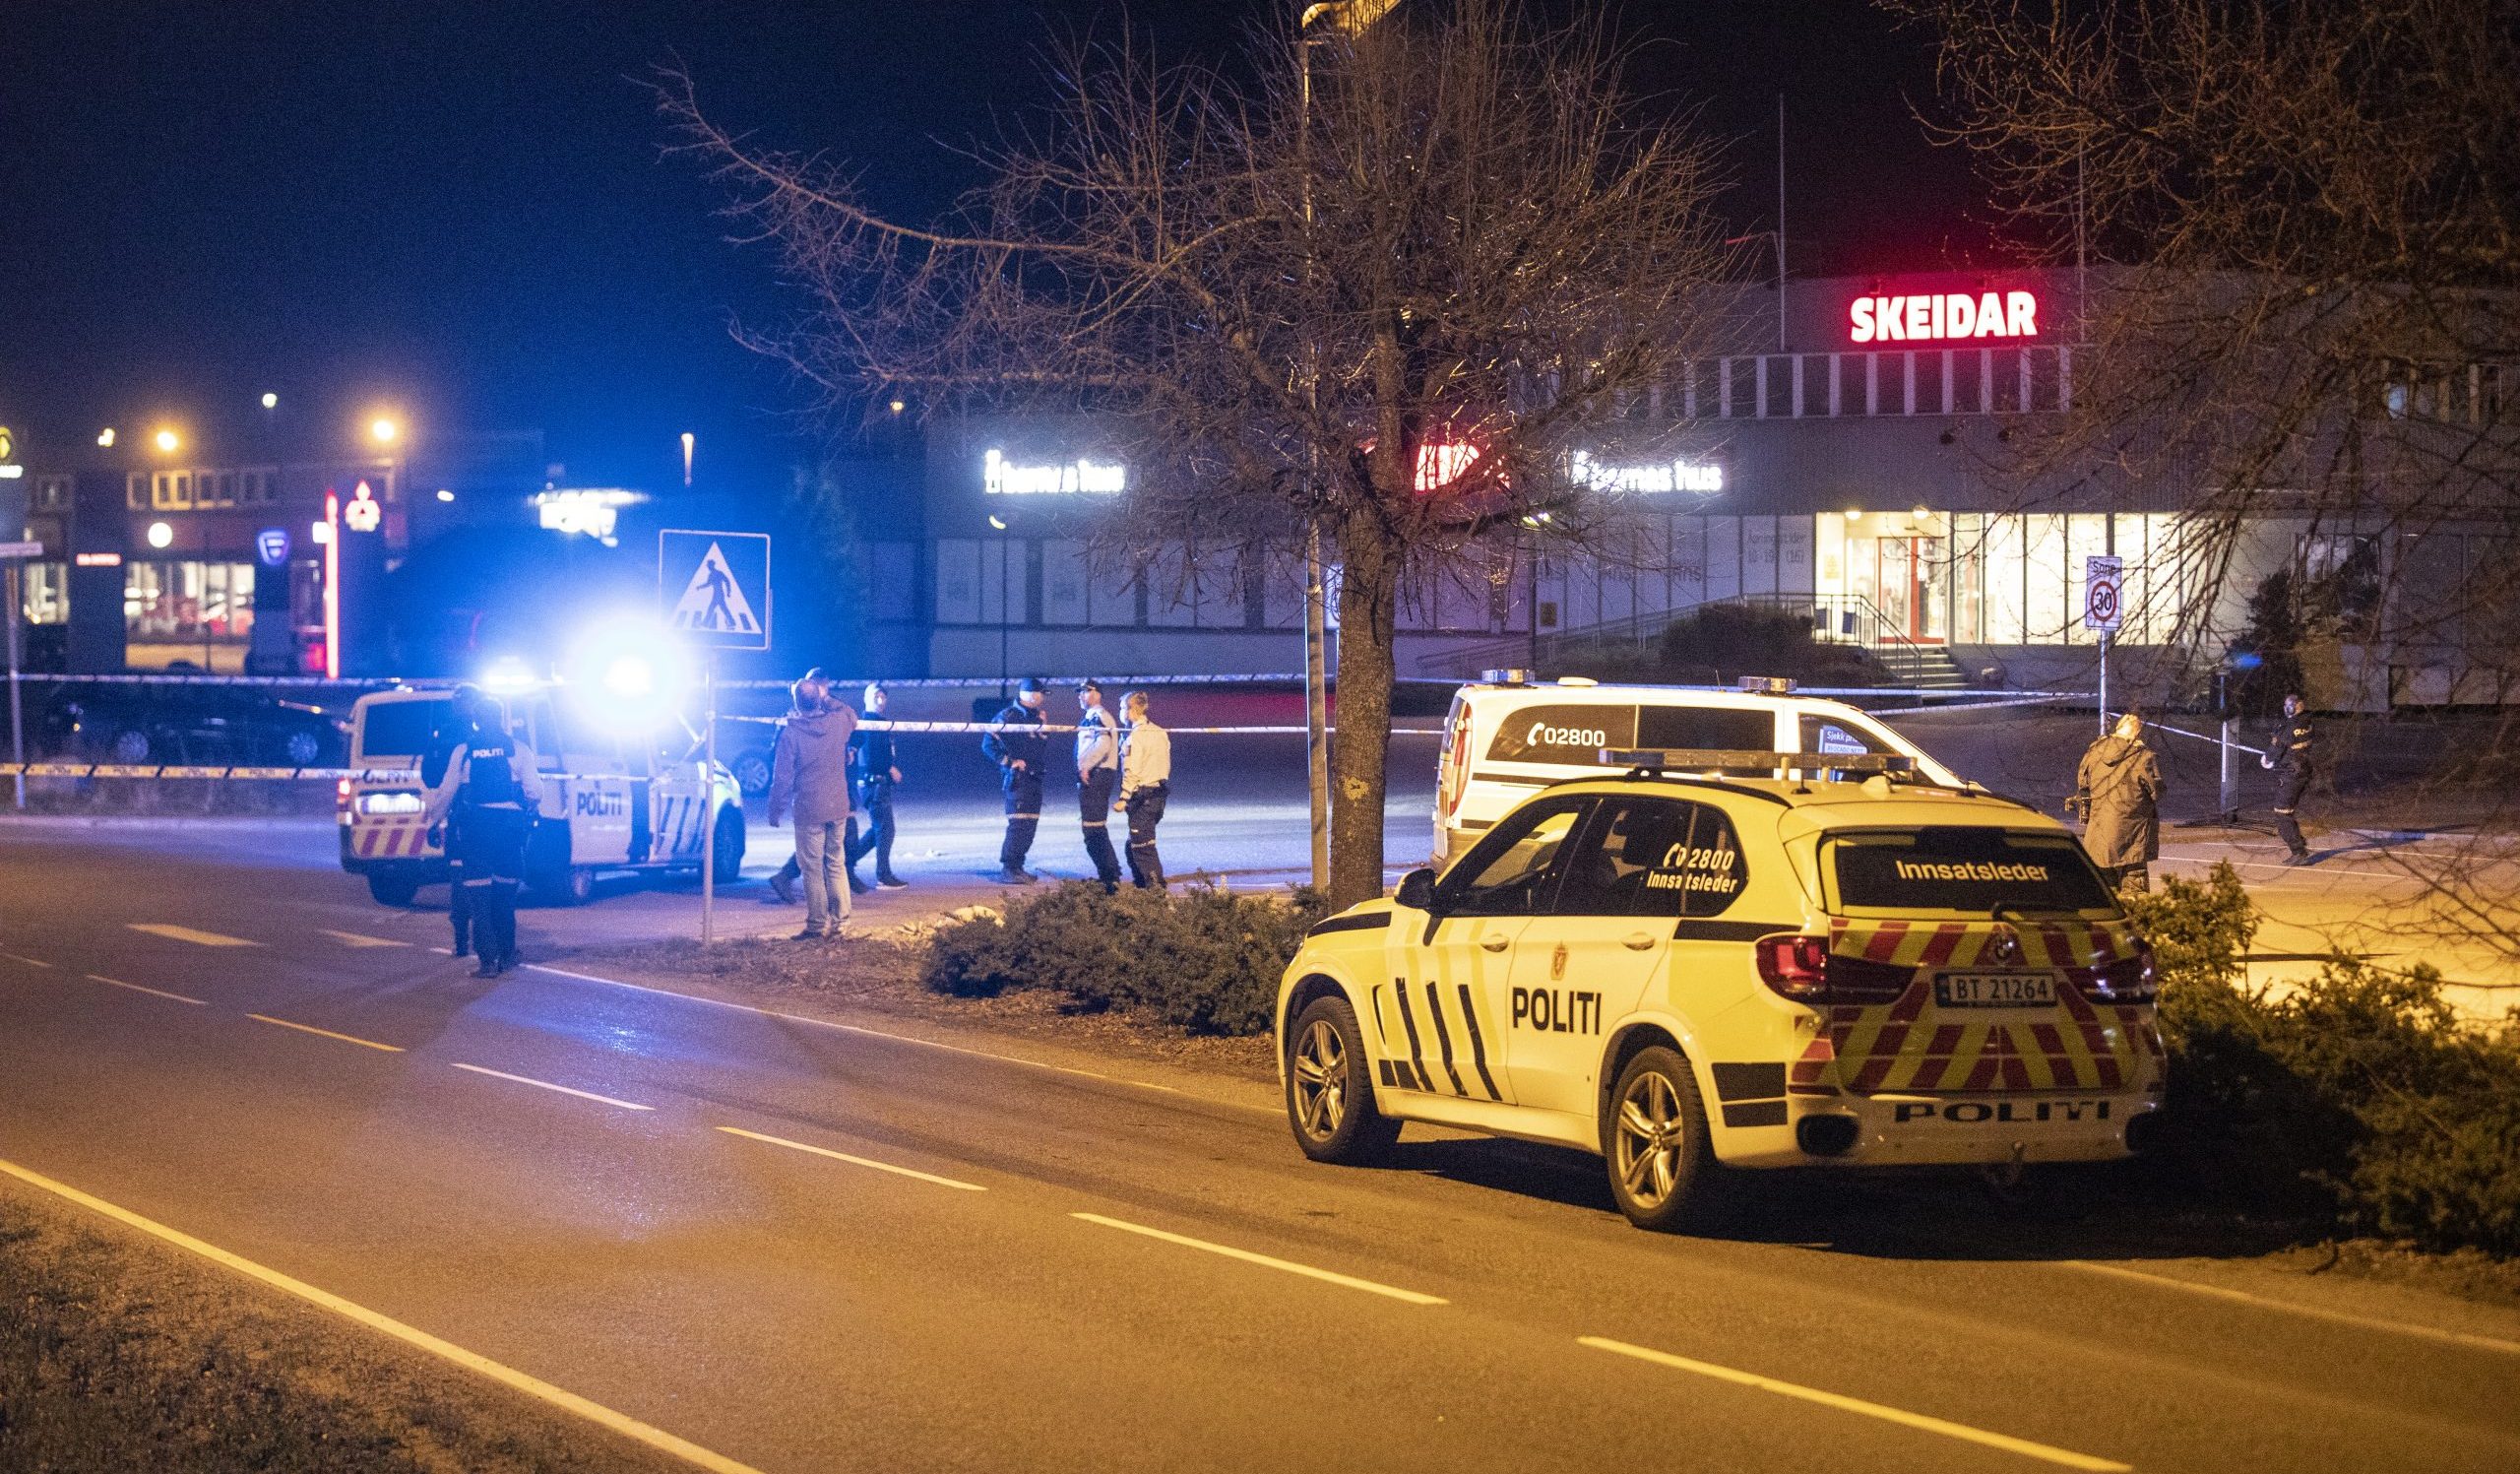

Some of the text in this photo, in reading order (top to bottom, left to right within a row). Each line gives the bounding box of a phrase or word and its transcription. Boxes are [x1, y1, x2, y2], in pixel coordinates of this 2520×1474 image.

[1851, 291, 2038, 343] SKEIDAR
[2095, 592, 2112, 610] 30
[1544, 727, 1606, 746] 02800
[577, 792, 622, 815] POLITI
[1896, 860, 2048, 881] Innsatsleder
[1956, 979, 2048, 999] BT 21264
[1512, 987, 1602, 1036] POLITI
[1895, 1101, 2110, 1122] POLITI
